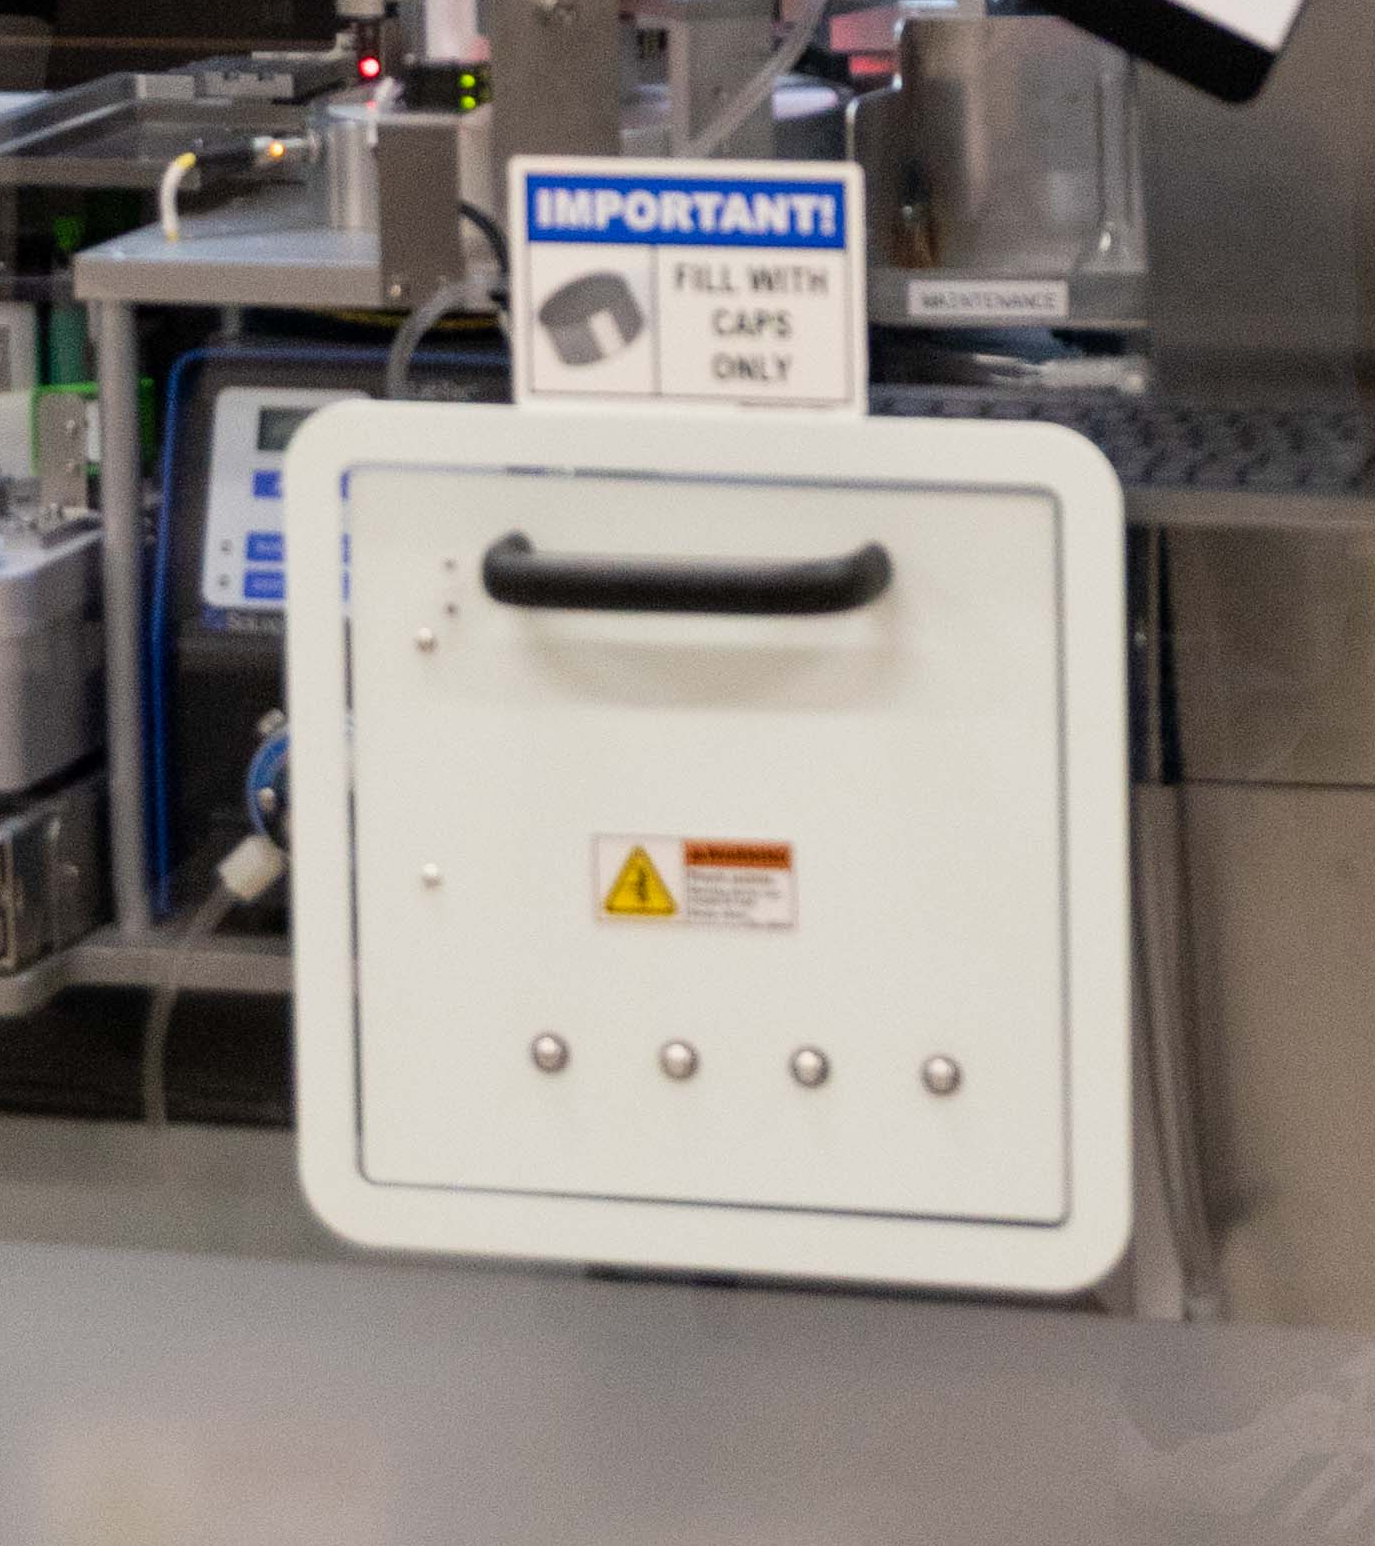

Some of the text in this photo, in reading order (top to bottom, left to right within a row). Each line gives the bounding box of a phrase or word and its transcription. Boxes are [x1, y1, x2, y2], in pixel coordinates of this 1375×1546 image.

[533, 186, 837, 238] IMPORTANT!
[674, 261, 829, 295] FILL WITH
[710, 309, 794, 339] CAPS
[710, 352, 794, 383] ONLY
